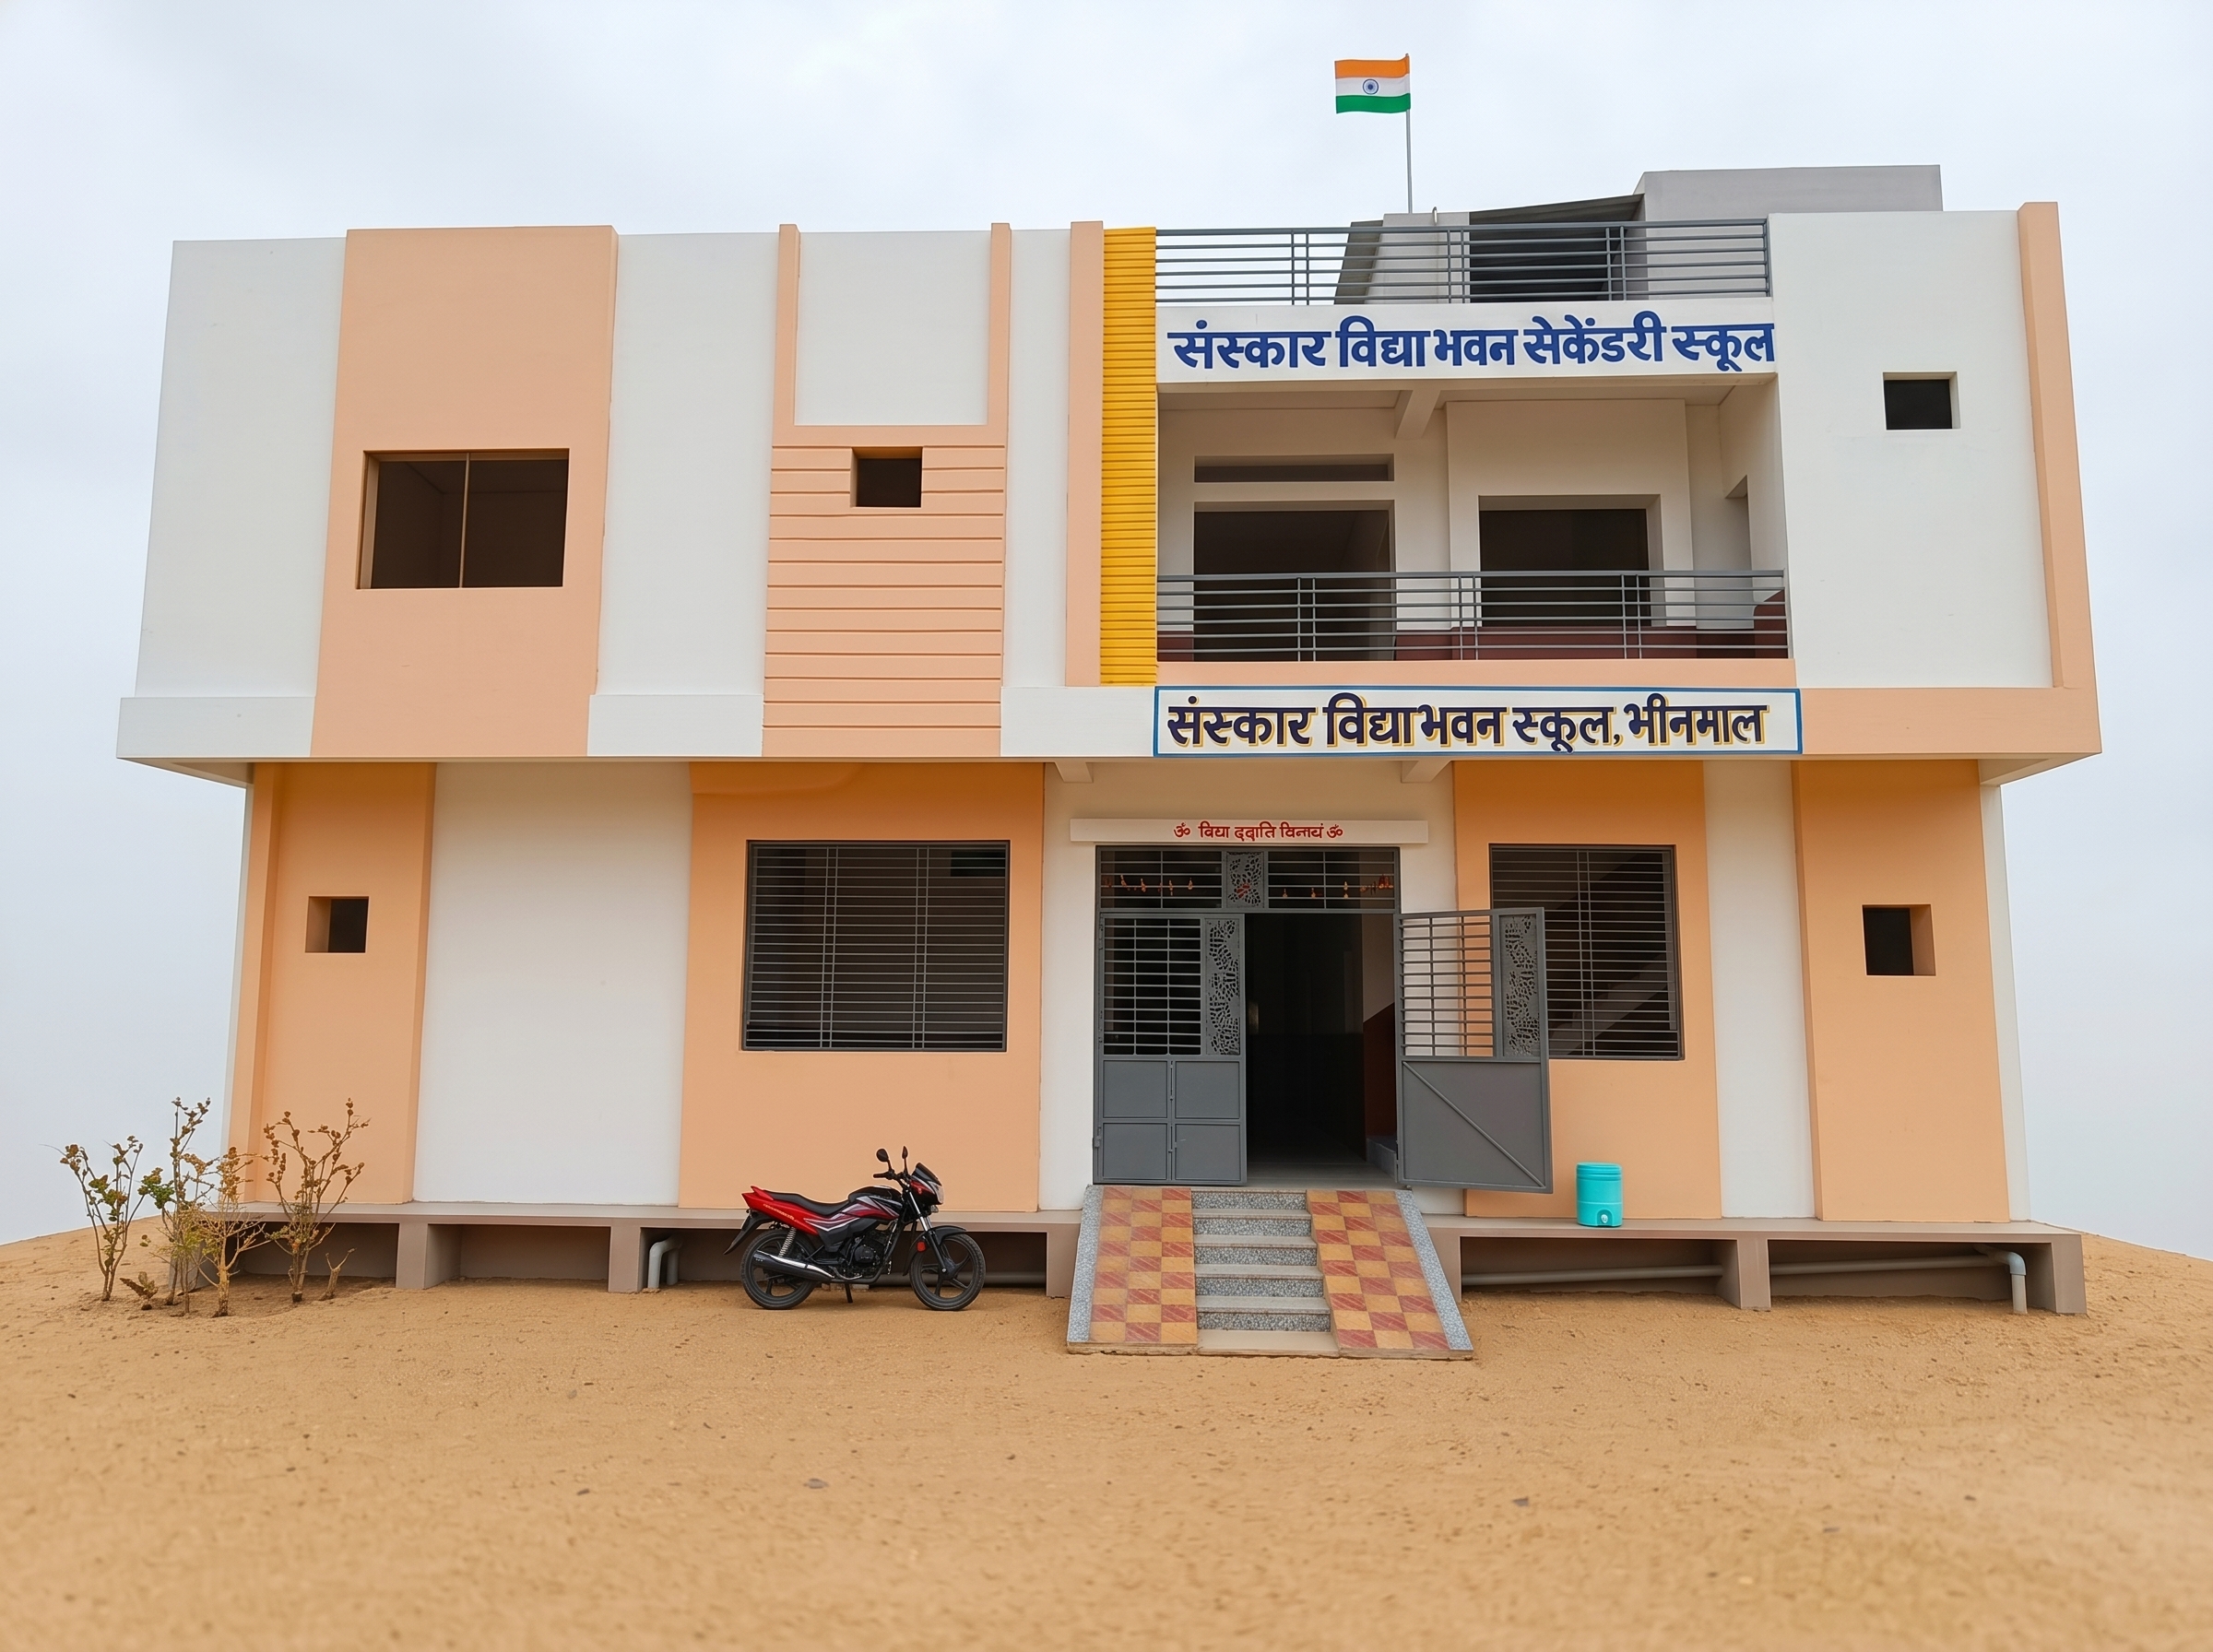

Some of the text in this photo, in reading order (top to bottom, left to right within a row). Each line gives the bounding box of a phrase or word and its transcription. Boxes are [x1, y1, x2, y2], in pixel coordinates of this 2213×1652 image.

[1166, 310, 1775, 372] संस्कार विद्या भवन सेकेंडरी स्कूल
[1166, 695, 1319, 747] संस्कार
[1511, 706, 1621, 753] स्कूल,
[1623, 691, 1769, 746] भीनमाल
